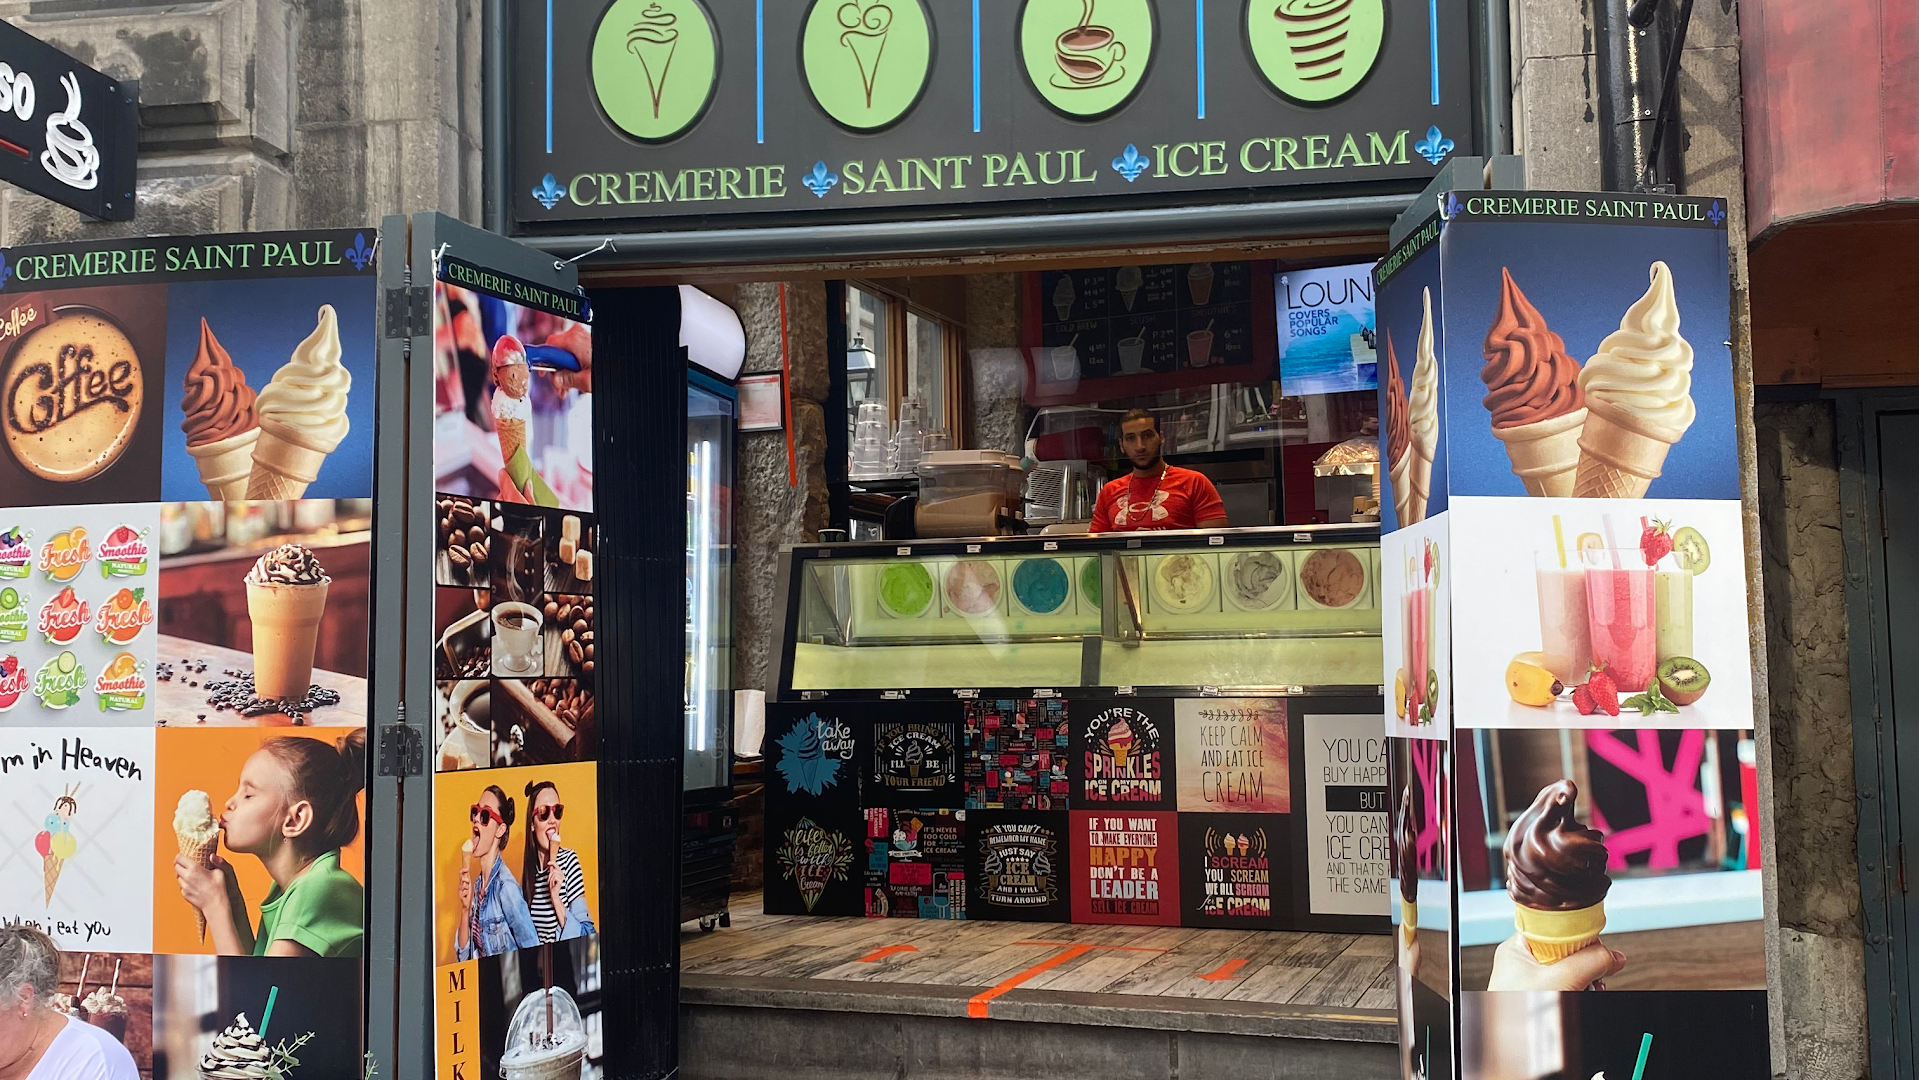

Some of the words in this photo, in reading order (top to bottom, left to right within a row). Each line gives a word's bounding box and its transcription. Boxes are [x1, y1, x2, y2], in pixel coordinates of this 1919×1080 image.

[569, 164, 787, 206] CREMERIE
[842, 155, 972, 196] SAINT
[982, 149, 1097, 187] PAUL
[1152, 140, 1228, 178] ICE
[1239, 130, 1411, 172] CREAM
[1466, 196, 1580, 217] CREMERIE
[1585, 198, 1648, 219] SAINT
[1652, 201, 1706, 222] PAUL
[15, 248, 157, 282] CREMERIE
[165, 242, 254, 272] SAINT
[262, 240, 342, 268] PAUL
[1376, 249, 1403, 286] CREMERIE
[1402, 233, 1420, 262] SAINT
[1420, 219, 1440, 247] PAUL
[448, 262, 512, 296] CREMERIE
[514, 282, 550, 307] SAINT
[551, 293, 581, 316] PAUL
[1286, 276, 1371, 310] LOUN
[1288, 308, 1330, 321] COVERS
[1289, 316, 1339, 329] POPULAR
[1290, 326, 1327, 338] SONGS
[8, 342, 134, 435] Coffee
[40, 539, 92, 570] Fresh
[98, 542, 148, 558] Smoothie
[39, 600, 92, 631] Fresh
[96, 600, 153, 632] Fresh
[34, 665, 87, 696] Fresh
[95, 677, 145, 691] Smoothie
[816, 717, 851, 740] take
[1084, 707, 1133, 740] YOU'RE
[1137, 710, 1160, 740] THE
[876, 739, 886, 753] IF
[885, 725, 904, 739] YOU
[907, 723, 940, 737] BRING
[940, 735, 954, 754] ME
[888, 734, 905, 749] ICE
[906, 731, 941, 749] CREAM
[1200, 725, 1226, 747] KEEP
[1230, 725, 1263, 747] CALM
[822, 738, 855, 759] away
[1322, 738, 1361, 763] YOU
[30, 742, 53, 770] in
[61, 737, 143, 782] Heaven
[925, 760, 940, 769] BE
[1084, 751, 1161, 779] SPRINKLES
[1201, 750, 1222, 767] AND
[1226, 750, 1243, 767] EAT
[1247, 750, 1264, 767] ICE
[883, 773, 910, 787] YOUR
[911, 774, 946, 787] FRIEND
[1323, 766, 1349, 783] BUY
[1085, 779, 1107, 801] ICE
[1111, 779, 1161, 801] CREAM
[1202, 771, 1264, 803] CREAM
[1360, 791, 1386, 810] BUT
[993, 825, 1002, 833] IF
[1002, 824, 1016, 832] YOU
[1089, 818, 1099, 831] IF
[1104, 818, 1123, 831] YOU
[1128, 818, 1157, 831] WANT
[1325, 814, 1354, 834] YOU
[1360, 814, 1388, 834] CAN
[989, 835, 1019, 845] REMEMBER
[1030, 836, 1047, 846] NAME
[1091, 832, 1099, 844] TO
[1102, 832, 1121, 845] MAKE
[1124, 833, 1156, 846] EVERYONE
[1326, 835, 1352, 860] ICE
[1359, 835, 1390, 860] CRE
[999, 847, 1018, 858] JUST
[1019, 848, 1036, 858] SAY
[1090, 847, 1157, 867] HAPPY
[800, 864, 826, 877] ICE
[1006, 862, 1030, 875] ICE
[1204, 856, 1208, 868] I
[1212, 856, 1269, 869] SCREAM
[1326, 862, 1346, 875] AND
[1349, 862, 1384, 876] THAT'S
[1000, 874, 1035, 886] CREAM
[1090, 865, 1125, 879] DON'T
[1130, 868, 1145, 880] BE
[1151, 868, 1159, 880] A
[1205, 868, 1223, 882] YOU
[1231, 869, 1269, 883] SCREAM
[800, 877, 824, 890] Cream
[997, 885, 1012, 893] AND
[1090, 880, 1159, 900] LEADER
[1205, 882, 1218, 895] WE
[1220, 882, 1234, 896] ALL
[1235, 883, 1270, 897] SCREAM
[1327, 876, 1349, 893] THE
[1353, 877, 1387, 894] SAME
[990, 894, 1012, 904] TURN
[1014, 895, 1047, 904] AROUND
[1092, 900, 1109, 913] SELL
[1115, 900, 1127, 913] ICE
[1131, 901, 1158, 915] CREAM
[1205, 897, 1224, 916] ICE
[1227, 896, 1271, 917] CREAM
[57, 919, 80, 935] eat
